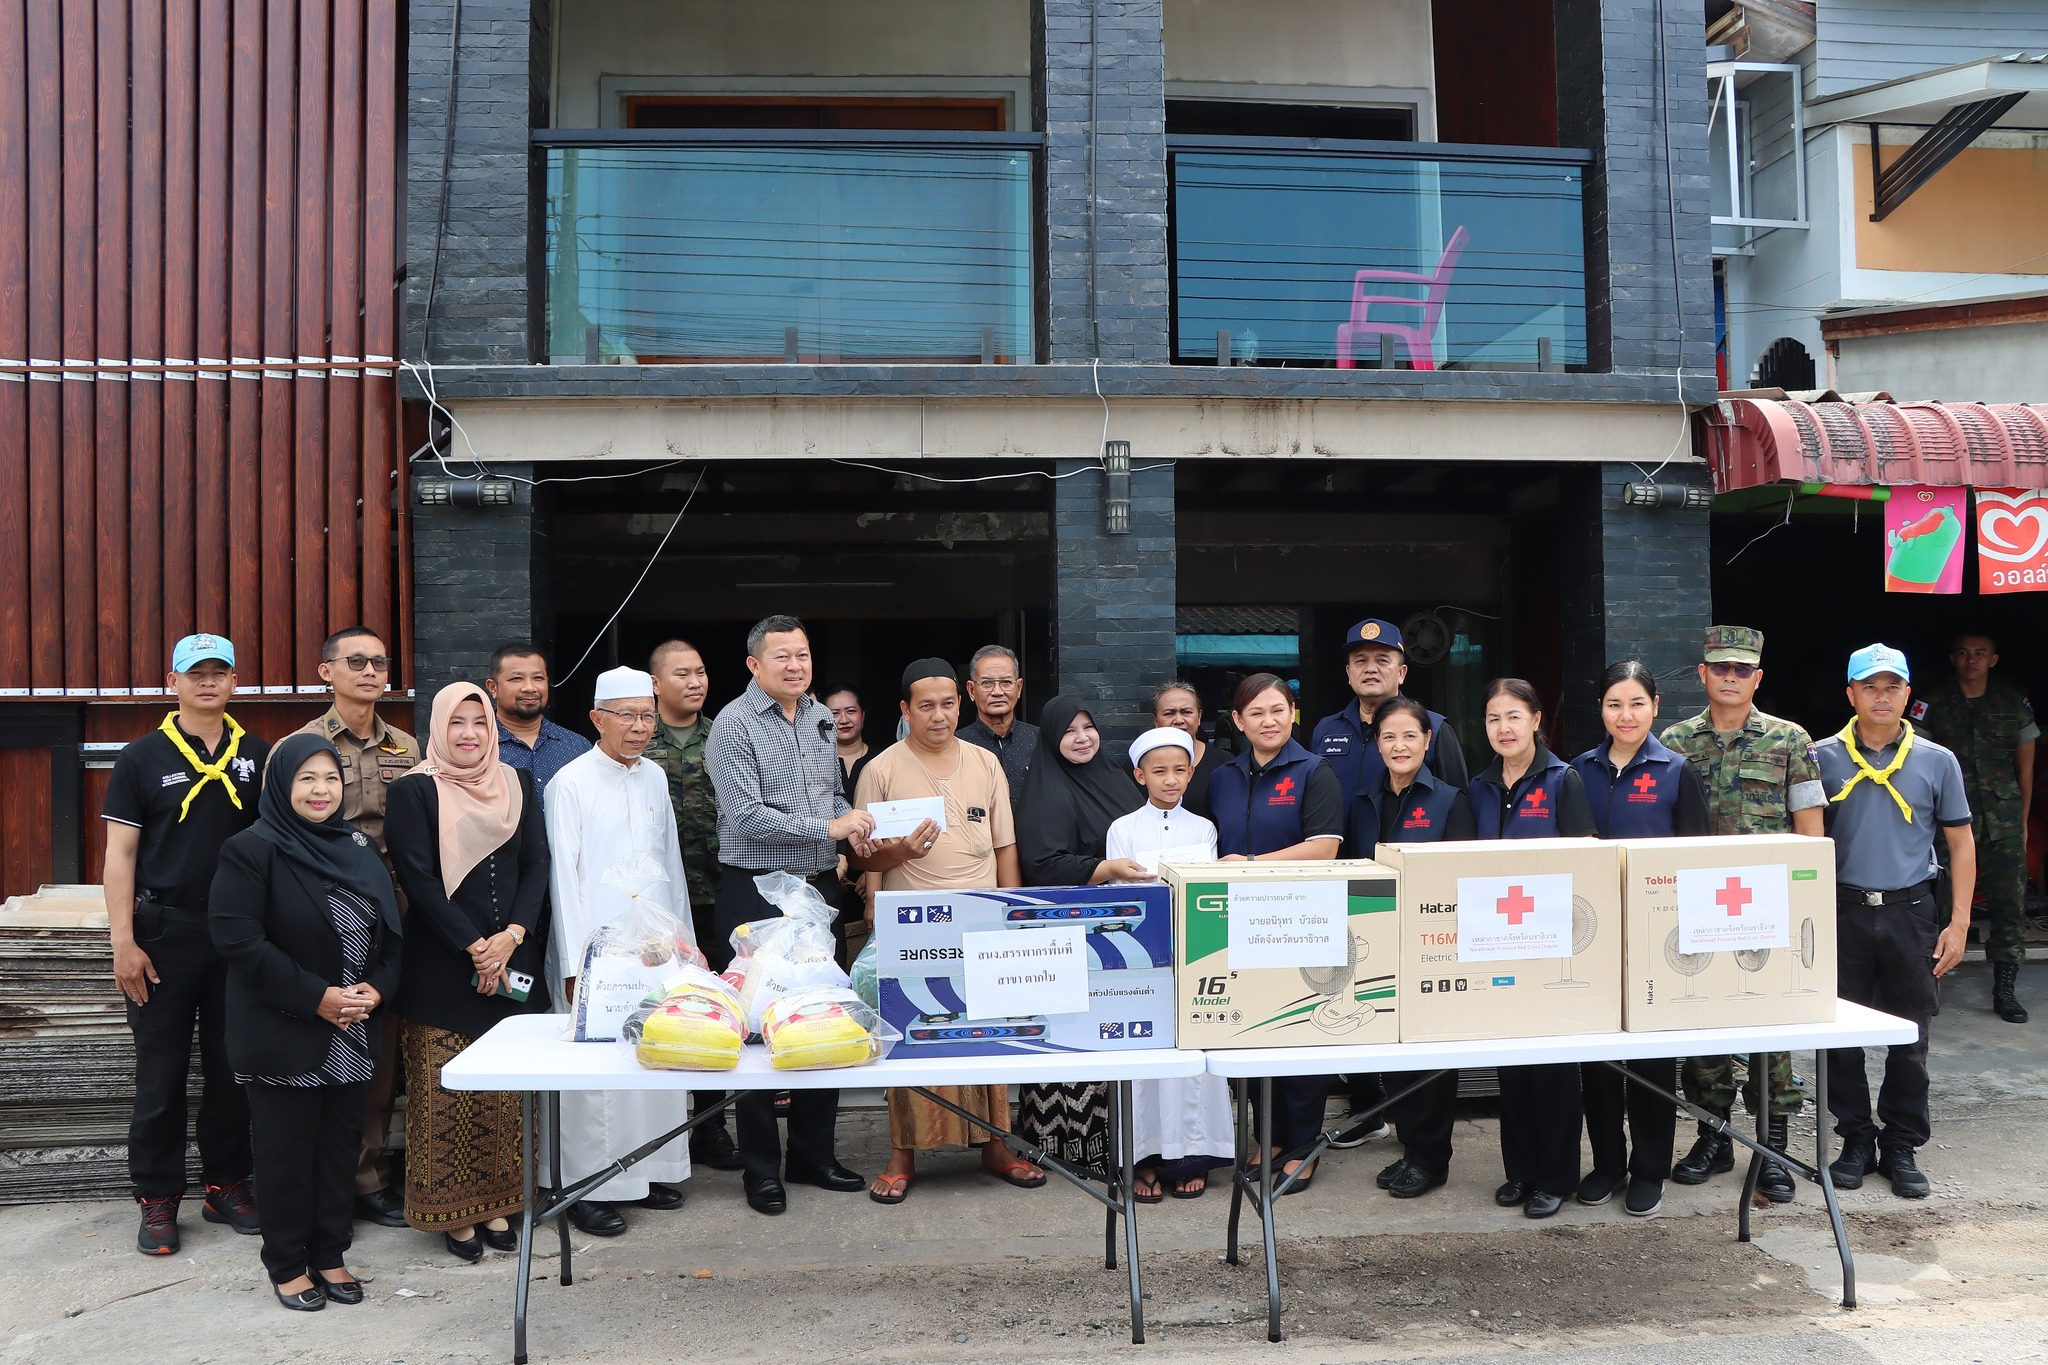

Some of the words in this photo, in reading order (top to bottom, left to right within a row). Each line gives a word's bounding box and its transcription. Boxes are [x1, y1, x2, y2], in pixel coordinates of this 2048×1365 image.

[1992, 563, 2048, 587] วอลล์
[1233, 893, 1293, 902] ด้วยความปรารถนาดี
[1299, 914, 1329, 925] บัวอ่อน
[1247, 933, 1330, 945] ปลัดจังหวัดนราธิวาส
[1472, 931, 1557, 943] เหล่ากาชาดจังหวัดนราธิวาส
[978, 938, 1073, 960] สนง.สรรพากรพื้นที่
[1421, 952, 1452, 963] Electric
[997, 975, 1022, 985] สาขา
[1024, 969, 1056, 984] ตากใบ
[1646, 979, 1654, 1005] Hatari
[1191, 996, 1231, 1006] Model
